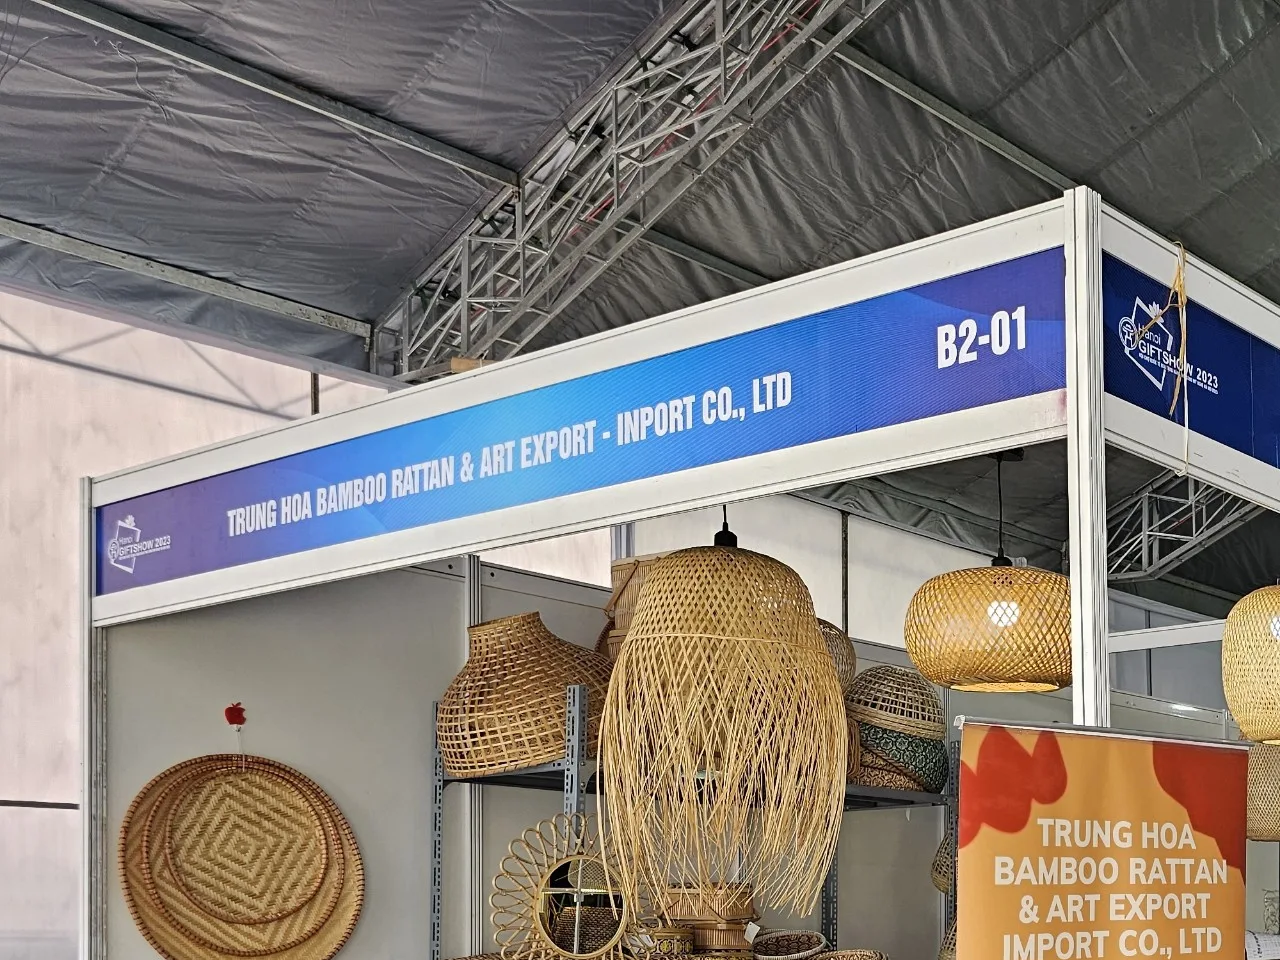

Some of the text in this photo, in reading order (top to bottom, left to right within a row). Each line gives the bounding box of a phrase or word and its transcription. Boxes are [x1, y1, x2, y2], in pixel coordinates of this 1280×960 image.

[936, 305, 1027, 369] B2-01
[1197, 366, 1219, 389] 2023
[227, 499, 277, 537] TRUNG
[281, 491, 312, 525] HOA
[316, 472, 387, 517] BAMBOO
[391, 455, 455, 499] RATTAN
[460, 451, 474, 483] &
[479, 440, 516, 479] ART
[520, 420, 597, 469] EXPORT
[617, 394, 696, 446] INPORT
[702, 386, 745, 425] CO.,
[752, 371, 792, 414] LTD
[119, 539, 154, 556] GIFTSHOW
[155, 535, 171, 548] 2023
[1037, 818, 1197, 850] TRUNG HOA
[994, 856, 1228, 886] BAMBOO RATTAN
[1019, 893, 1211, 924] & ART EXPORT
[1118, 929, 1172, 960] CO.,
[1179, 926, 1222, 954] LTD
